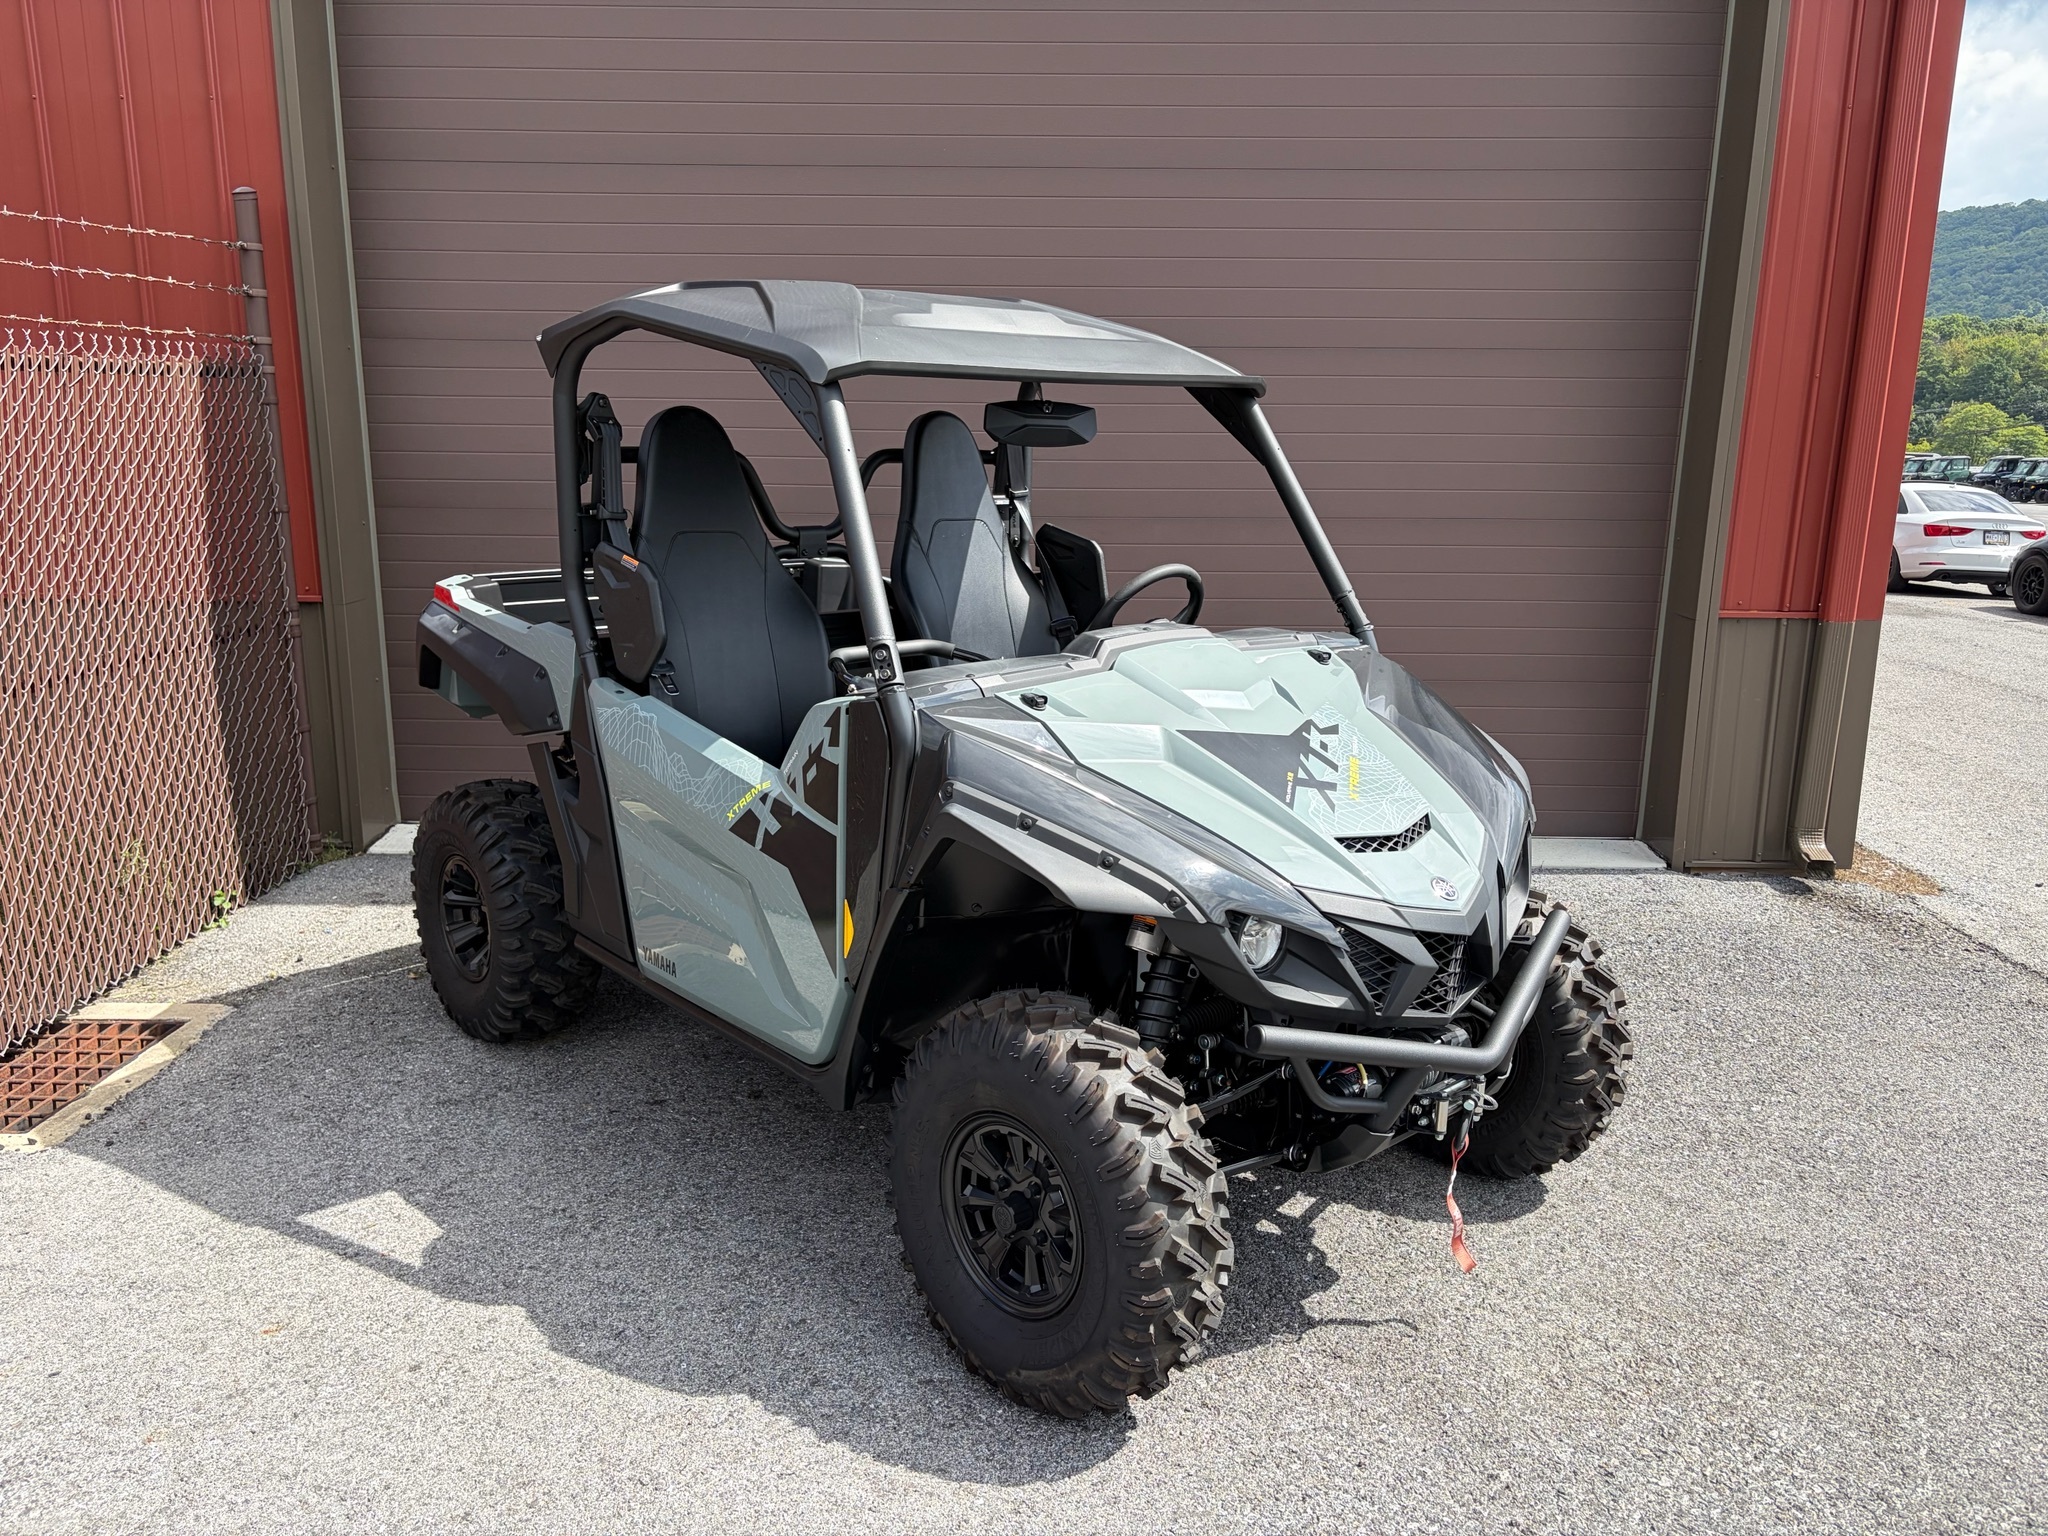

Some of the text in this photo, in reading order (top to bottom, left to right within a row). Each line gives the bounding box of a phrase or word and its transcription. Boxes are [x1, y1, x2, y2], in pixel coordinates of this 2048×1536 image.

[1349, 756, 1359, 801] XTREME
[726, 780, 772, 822] XTREME
[642, 945, 677, 978] YAMAHA
